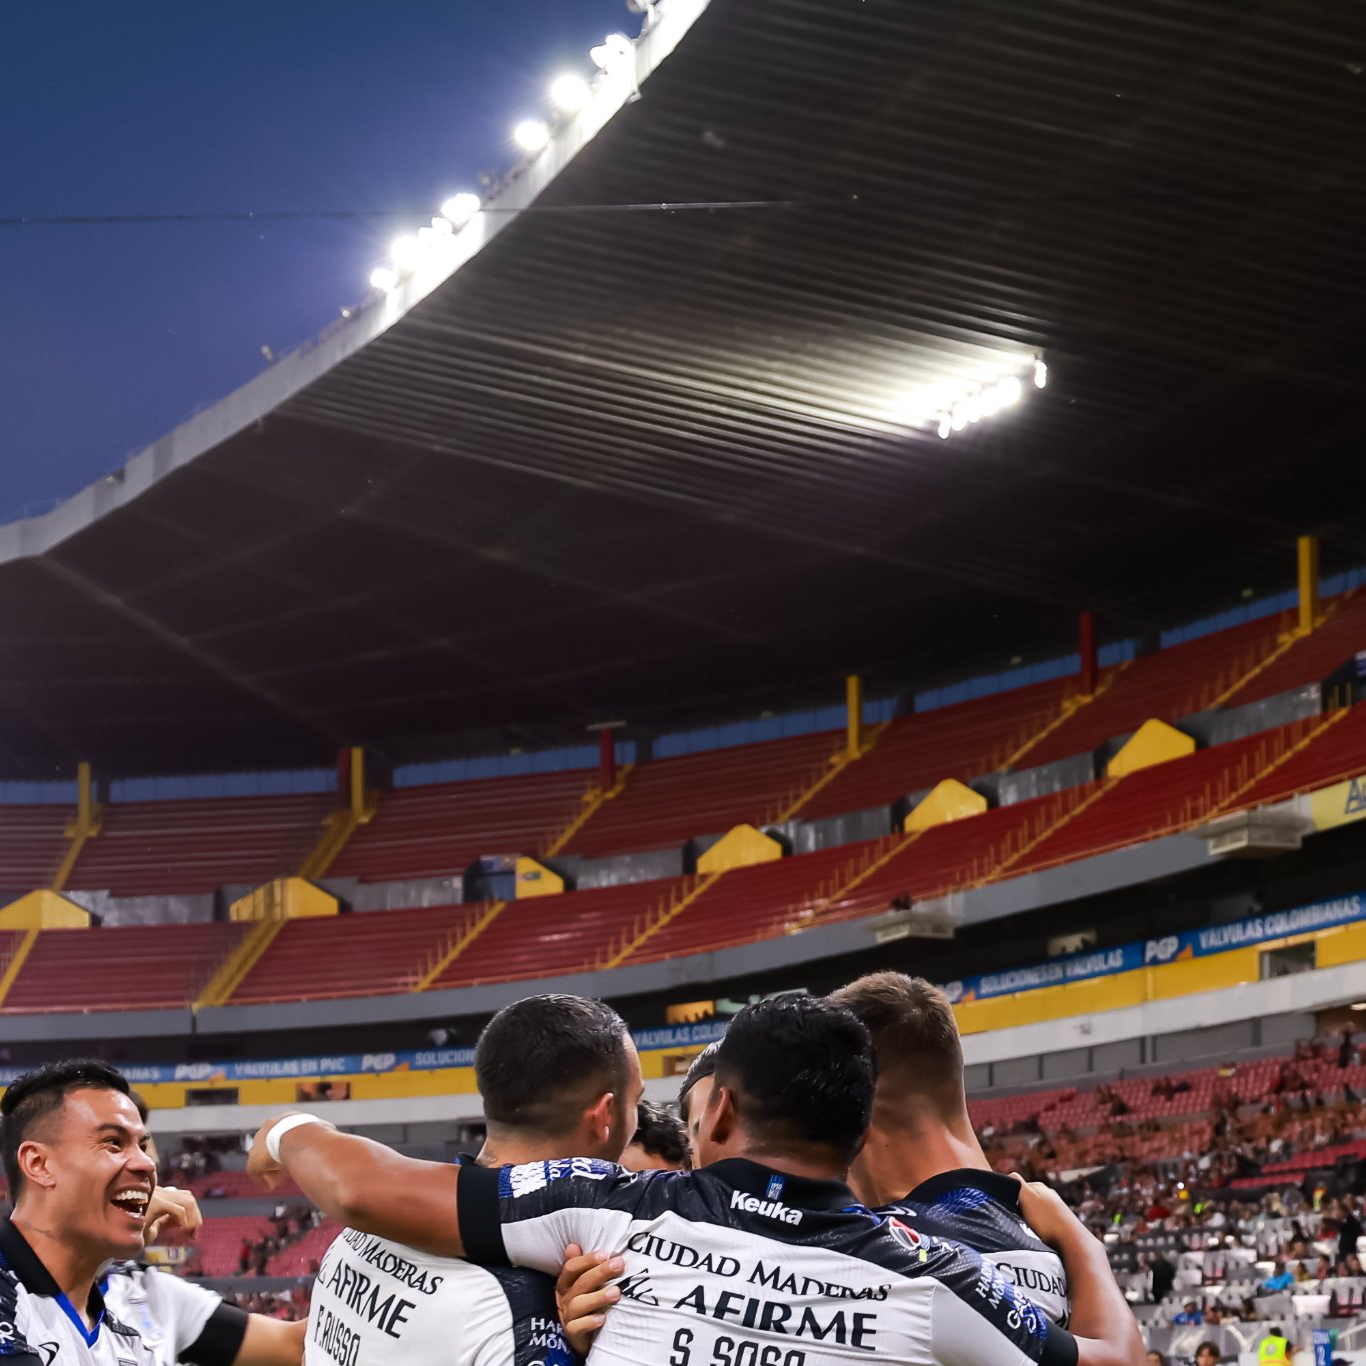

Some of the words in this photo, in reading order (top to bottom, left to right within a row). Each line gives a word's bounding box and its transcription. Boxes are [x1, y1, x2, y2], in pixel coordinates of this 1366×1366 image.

[731, 1189, 804, 1226] Keuka
[326, 1258, 417, 1340] AFIRME
[358, 1237, 445, 1295] MADERAS
[626, 1231, 741, 1278] CIUDAD
[746, 1260, 892, 1302] MADERAS
[673, 1284, 878, 1351] AFIRME
